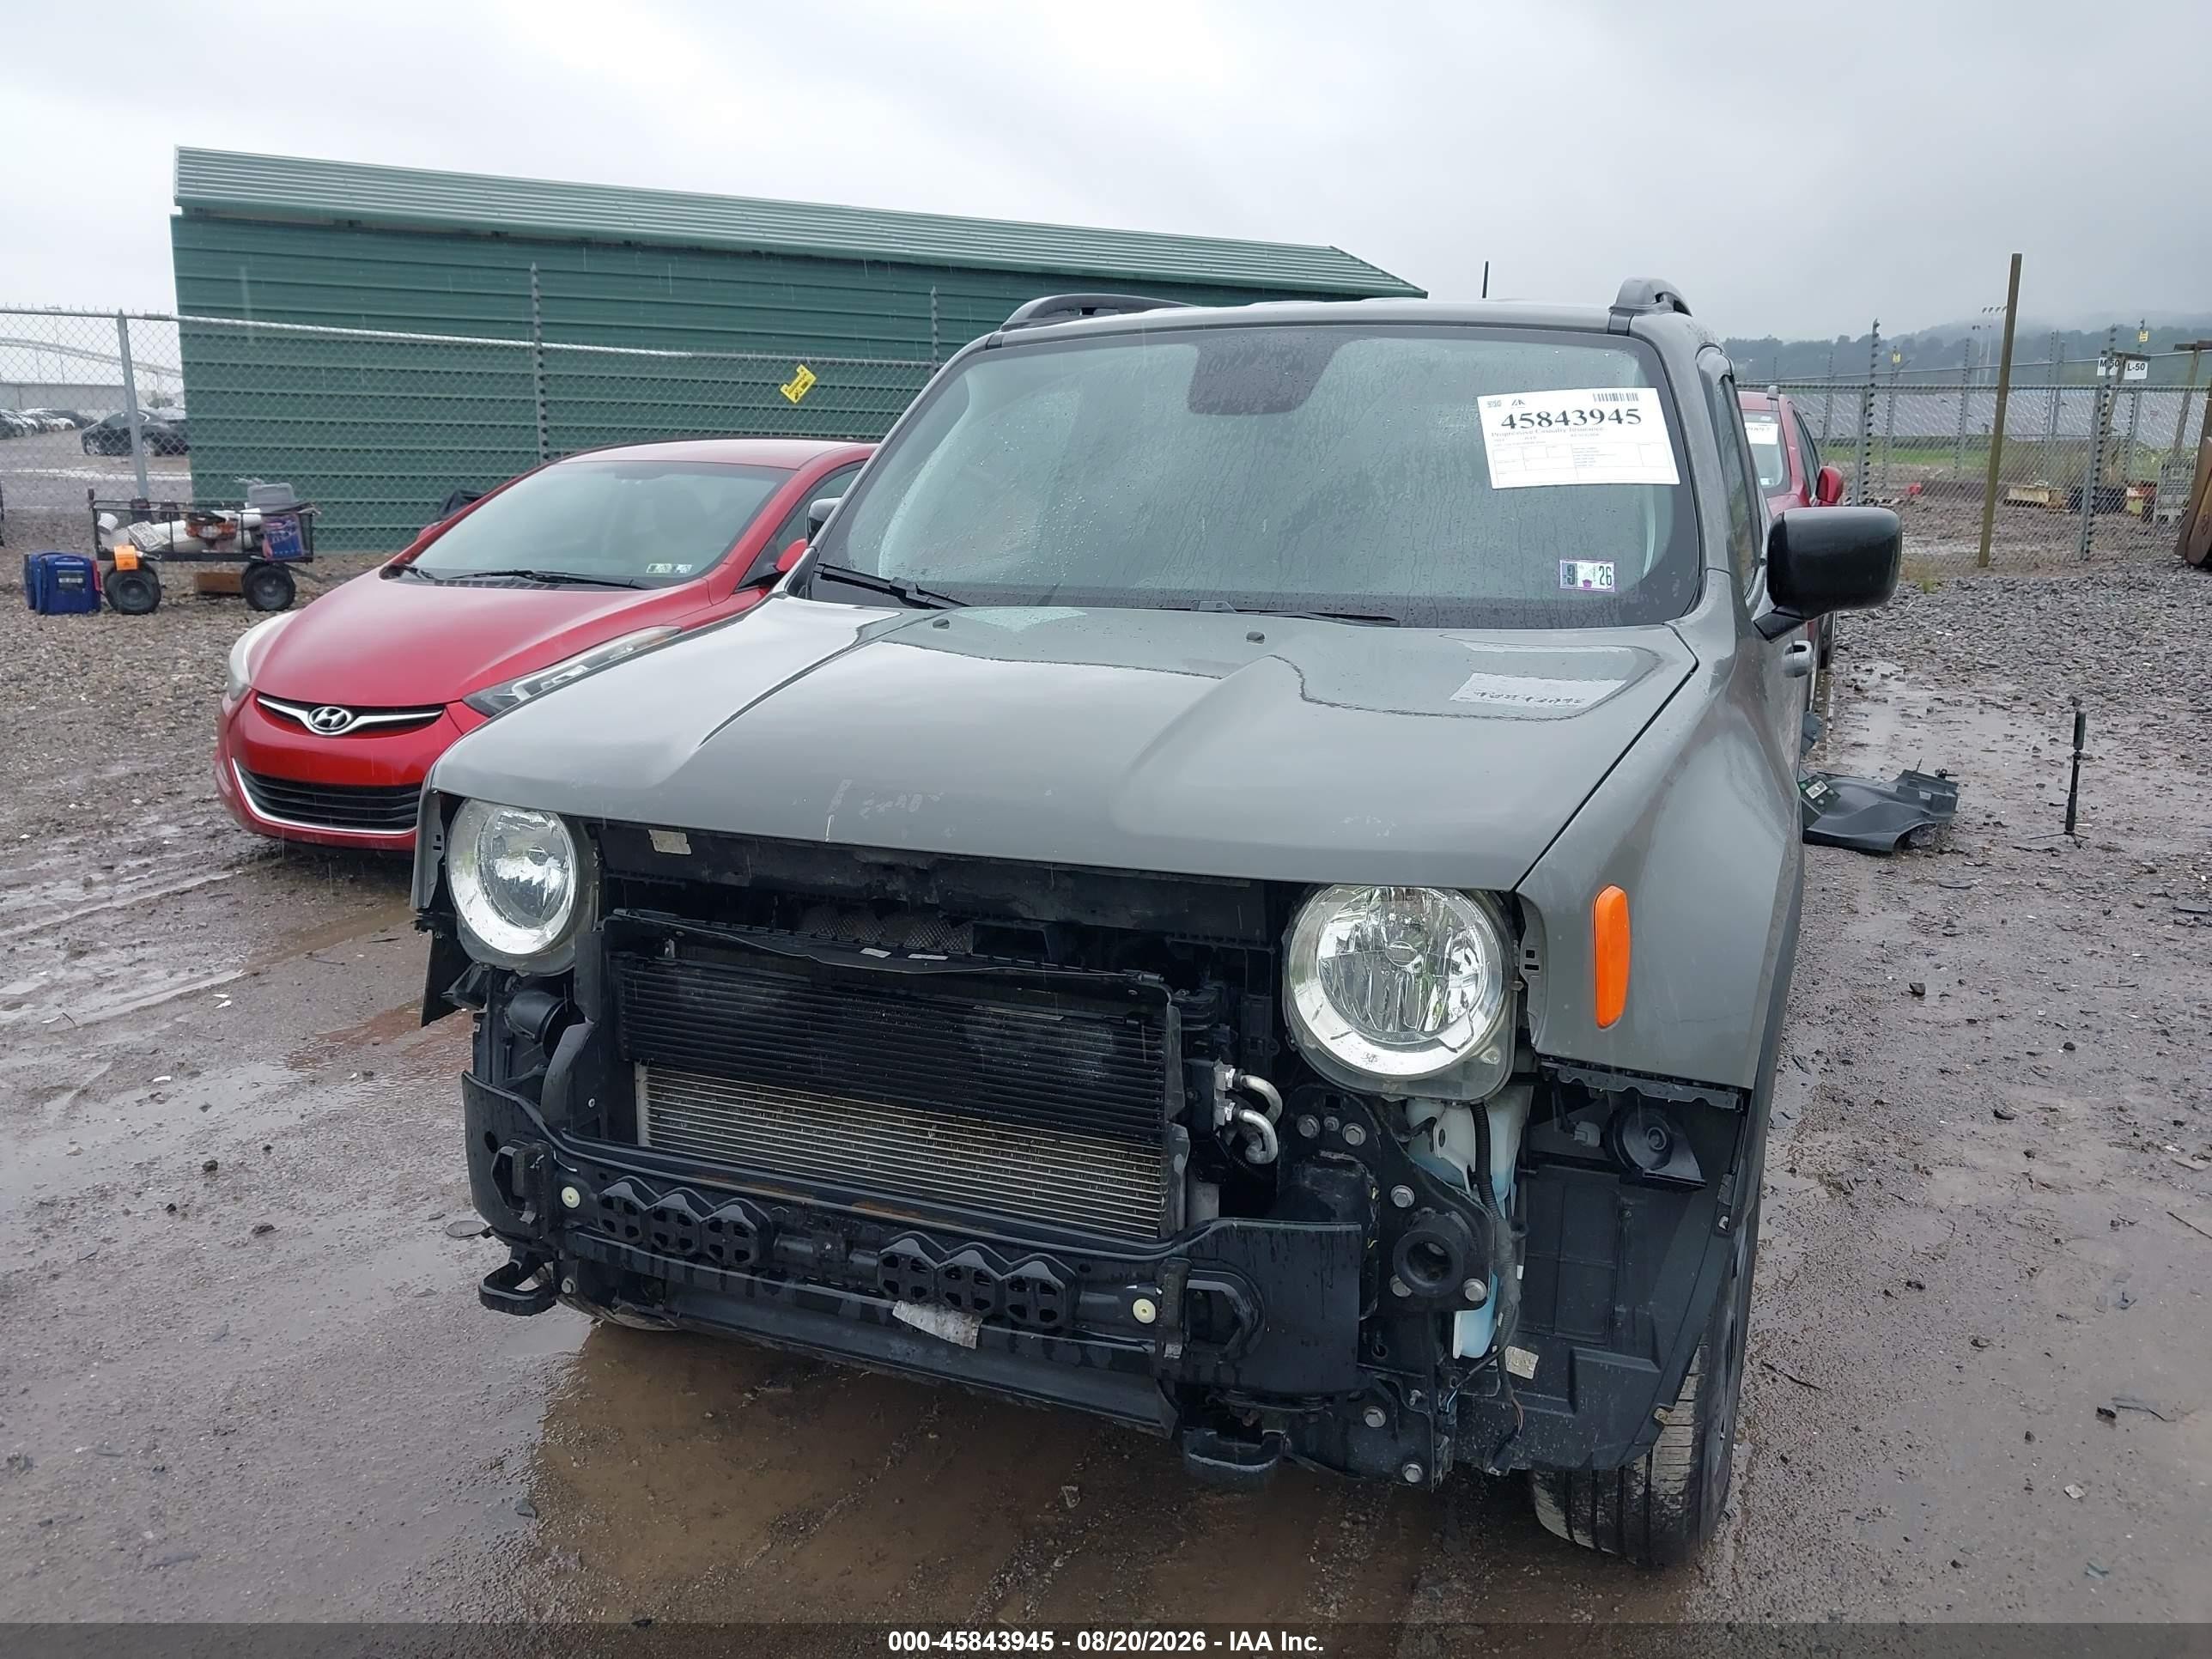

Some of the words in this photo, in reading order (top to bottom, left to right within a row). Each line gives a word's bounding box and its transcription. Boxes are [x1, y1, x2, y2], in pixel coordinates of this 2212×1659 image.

[2100, 359, 2120, 368] M50
[2127, 362, 2146, 371] L-50
[1500, 408, 1642, 429] 45843945
[1599, 565, 1613, 586] 26
